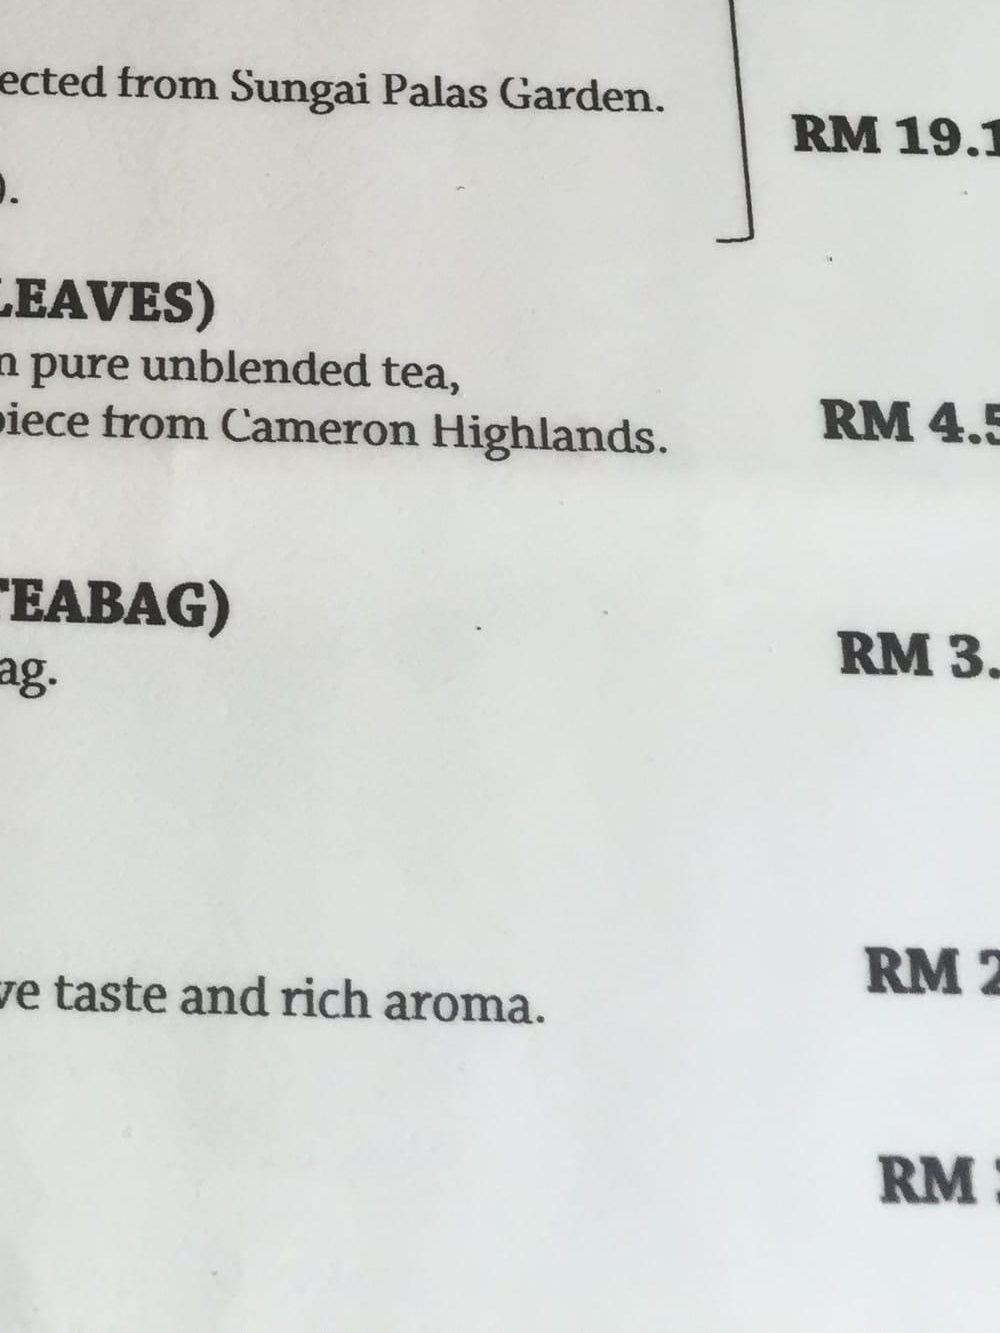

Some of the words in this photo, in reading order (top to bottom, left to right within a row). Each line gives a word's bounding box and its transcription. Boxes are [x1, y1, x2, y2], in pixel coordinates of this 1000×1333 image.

[117, 65, 220, 101] from
[230, 68, 371, 116] Sungai
[381, 73, 489, 109] Palas
[499, 76, 665, 113] Garden.
[790, 113, 882, 155] RM
[30, 352, 130, 389] pure
[140, 348, 372, 388] unblended
[381, 356, 460, 396] tea,
[101, 404, 209, 441] from
[221, 407, 420, 447] Cameron
[431, 413, 668, 462] Highlands.
[819, 398, 915, 443] RM
[836, 630, 934, 677] RM
[864, 946, 963, 995] RM
[53, 974, 168, 1014] taste
[179, 975, 270, 1017] and
[280, 976, 372, 1020] rich
[383, 990, 545, 1025] aroma.
[877, 1154, 977, 1205] RM
